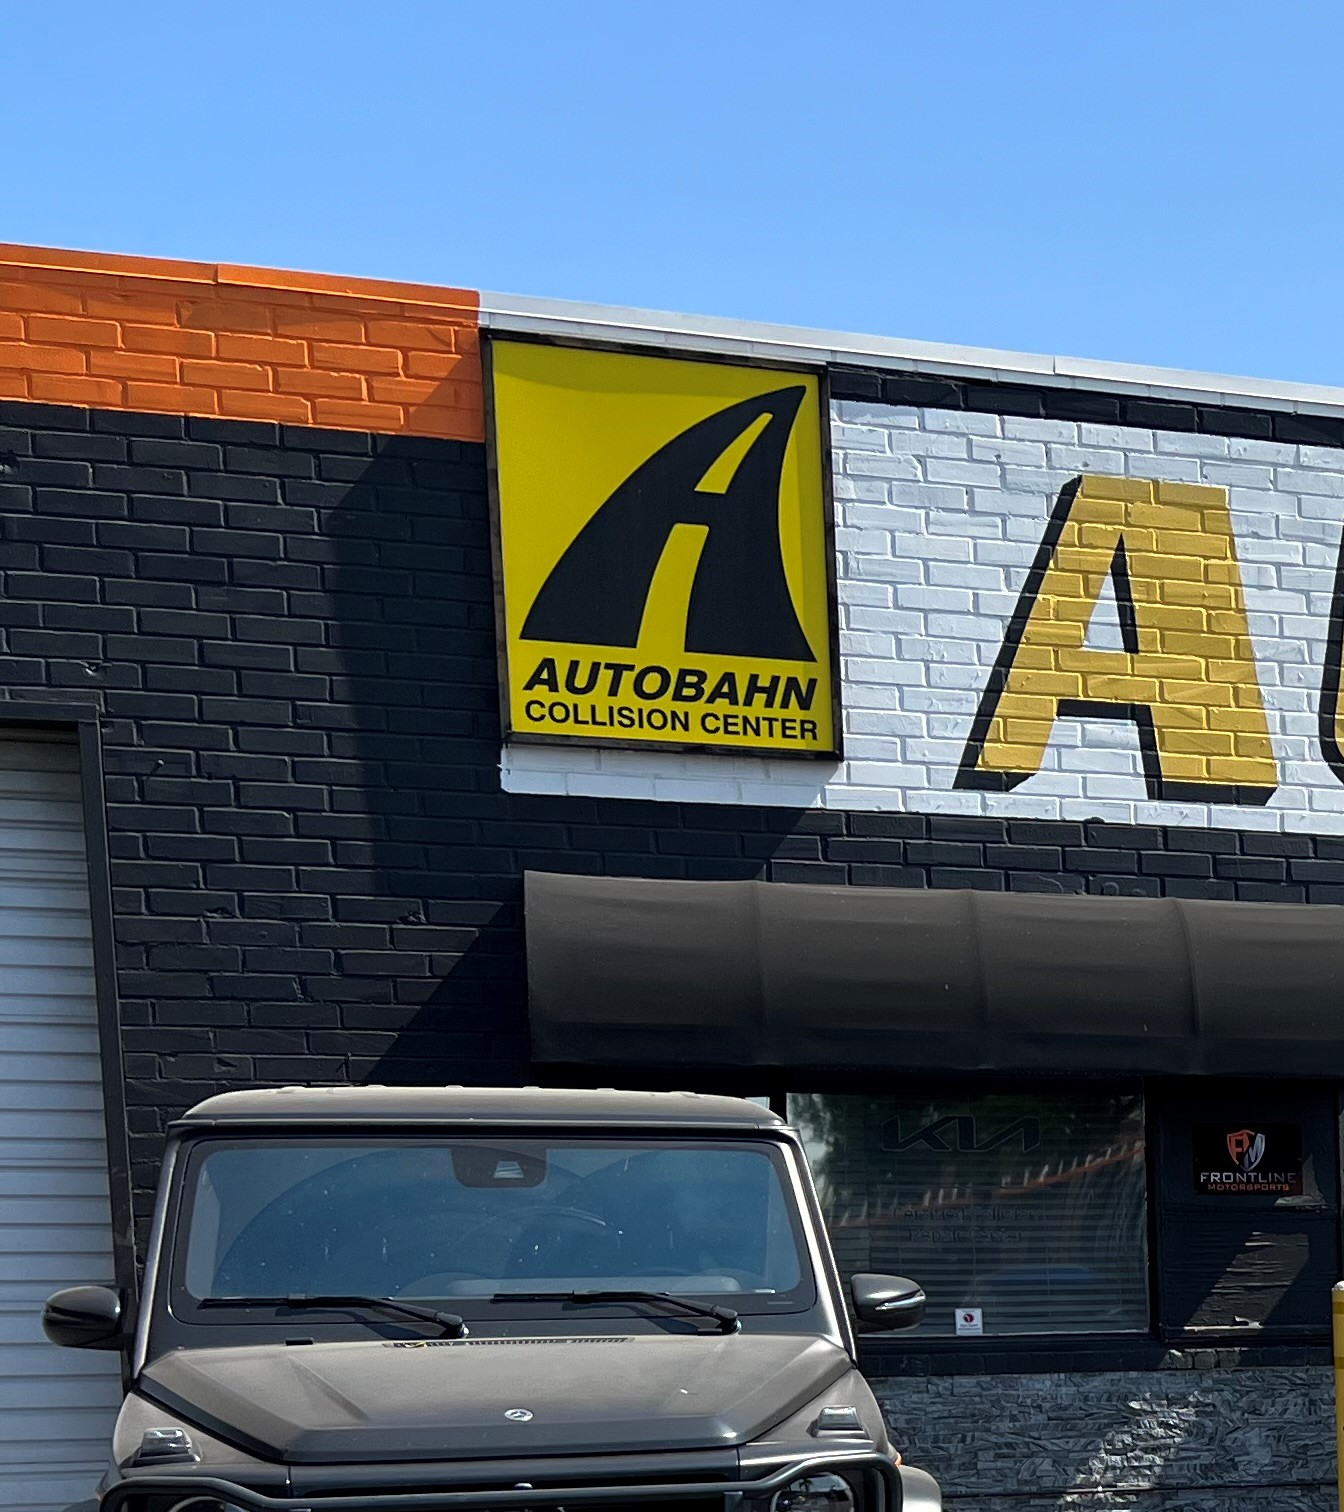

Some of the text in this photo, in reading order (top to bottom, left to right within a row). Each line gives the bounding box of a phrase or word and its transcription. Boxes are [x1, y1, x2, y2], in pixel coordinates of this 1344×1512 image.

[522, 657, 817, 711] AUTOBAHN
[525, 699, 818, 740] COLLISION CENTER
[1200, 1172, 1297, 1183] FRONTLINE
[1207, 1183, 1290, 1191] MOTORSPORTS
